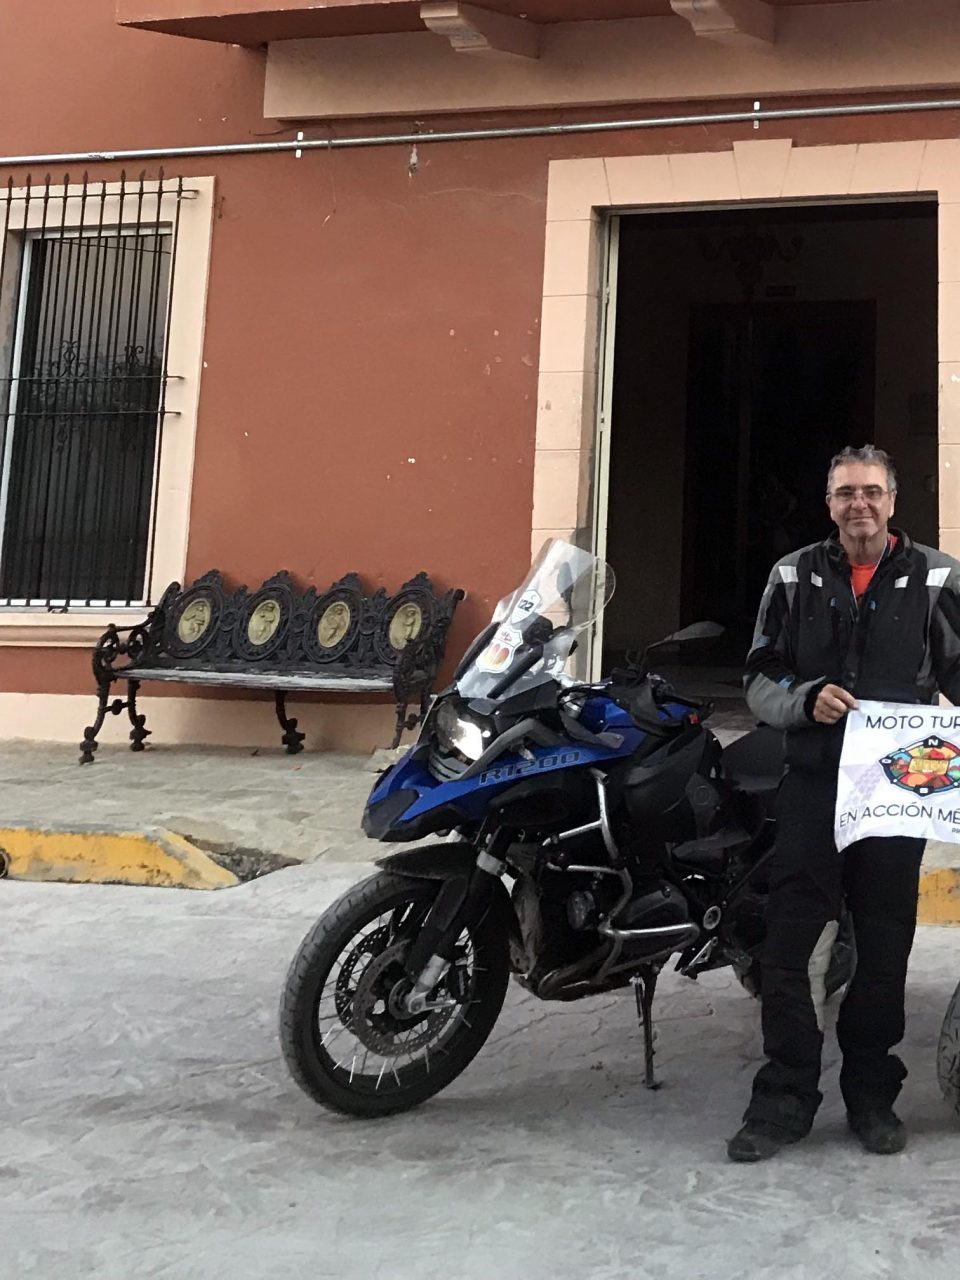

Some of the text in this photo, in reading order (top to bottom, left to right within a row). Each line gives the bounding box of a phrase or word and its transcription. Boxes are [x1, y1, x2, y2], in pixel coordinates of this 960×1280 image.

[865, 715, 924, 730] MOTO
[928, 738, 939, 747] N
[839, 809, 858, 828] EN
[861, 801, 933, 819] ACCIÓN
